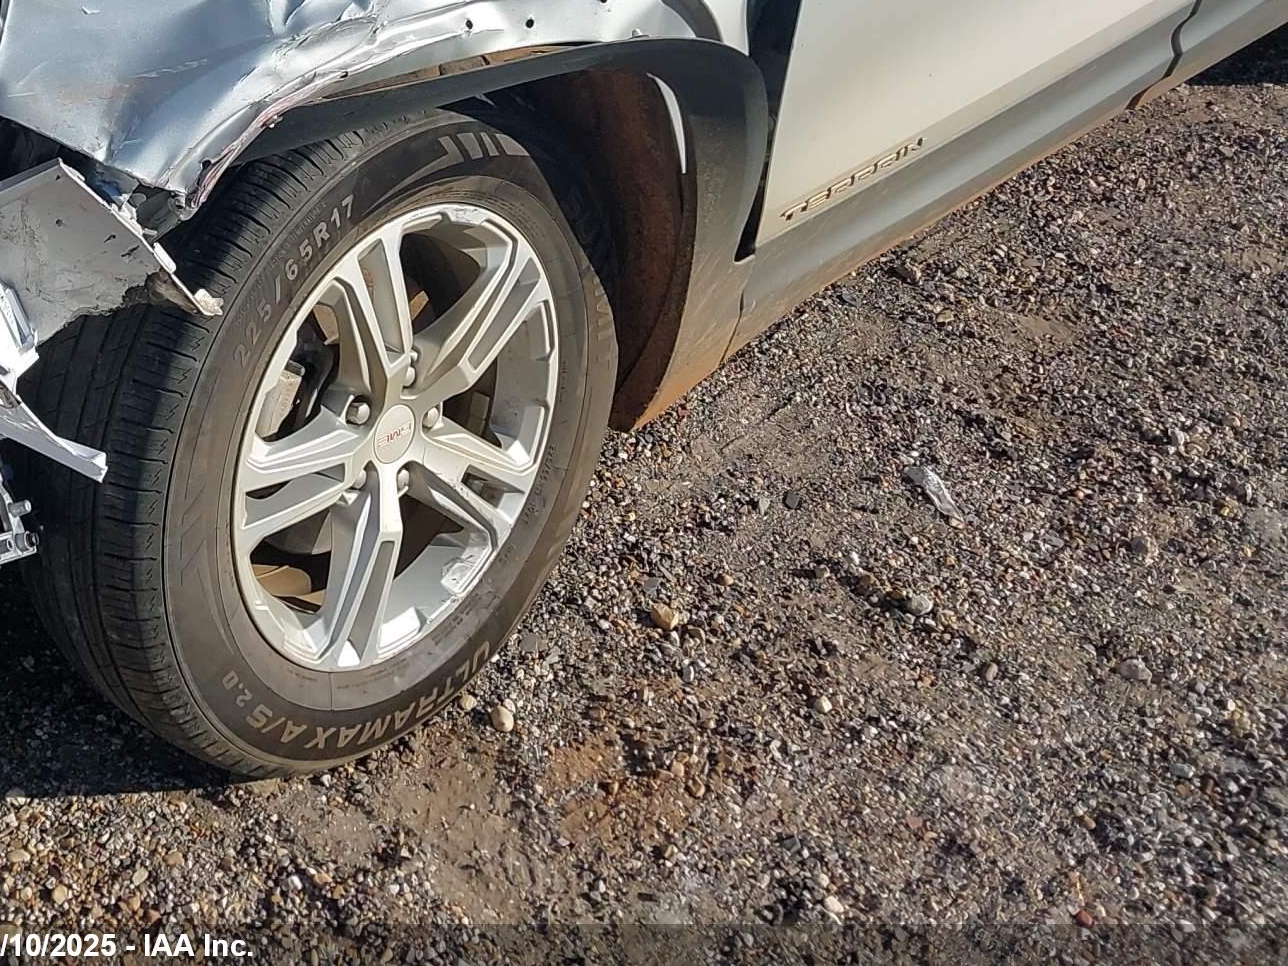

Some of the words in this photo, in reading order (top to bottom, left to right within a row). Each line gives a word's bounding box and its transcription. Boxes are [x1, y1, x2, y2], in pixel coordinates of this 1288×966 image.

[234, 194, 355, 369] 225/65R17
[245, 704, 308, 743] A/S
[304, 640, 490, 749] ULTRAMAX
